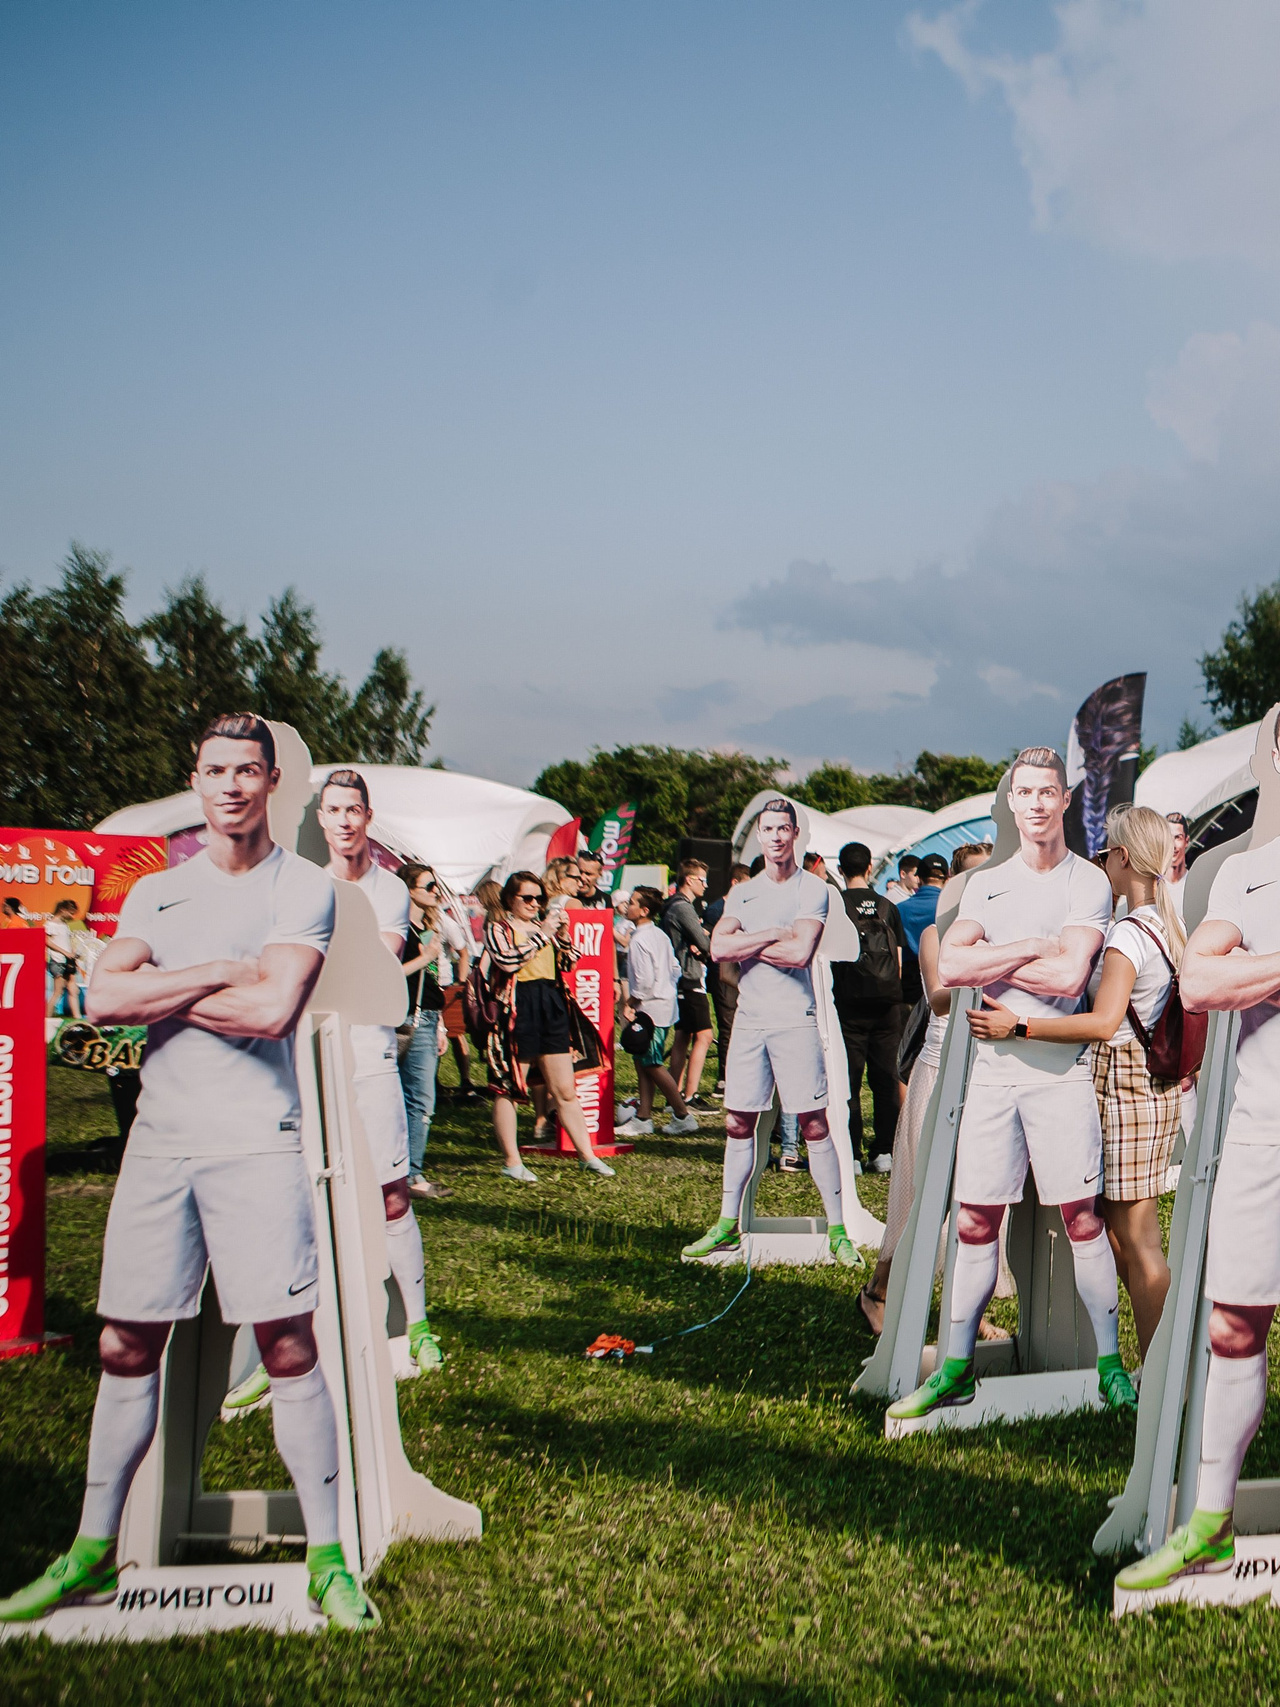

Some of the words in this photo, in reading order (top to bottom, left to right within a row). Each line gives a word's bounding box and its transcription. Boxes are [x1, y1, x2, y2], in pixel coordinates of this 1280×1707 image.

[600, 820, 620, 866] ГОШ
[44, 864, 95, 886] ГОШ
[574, 922, 604, 956] CR7
[117, 1583, 274, 1612] #РИВГОШ
